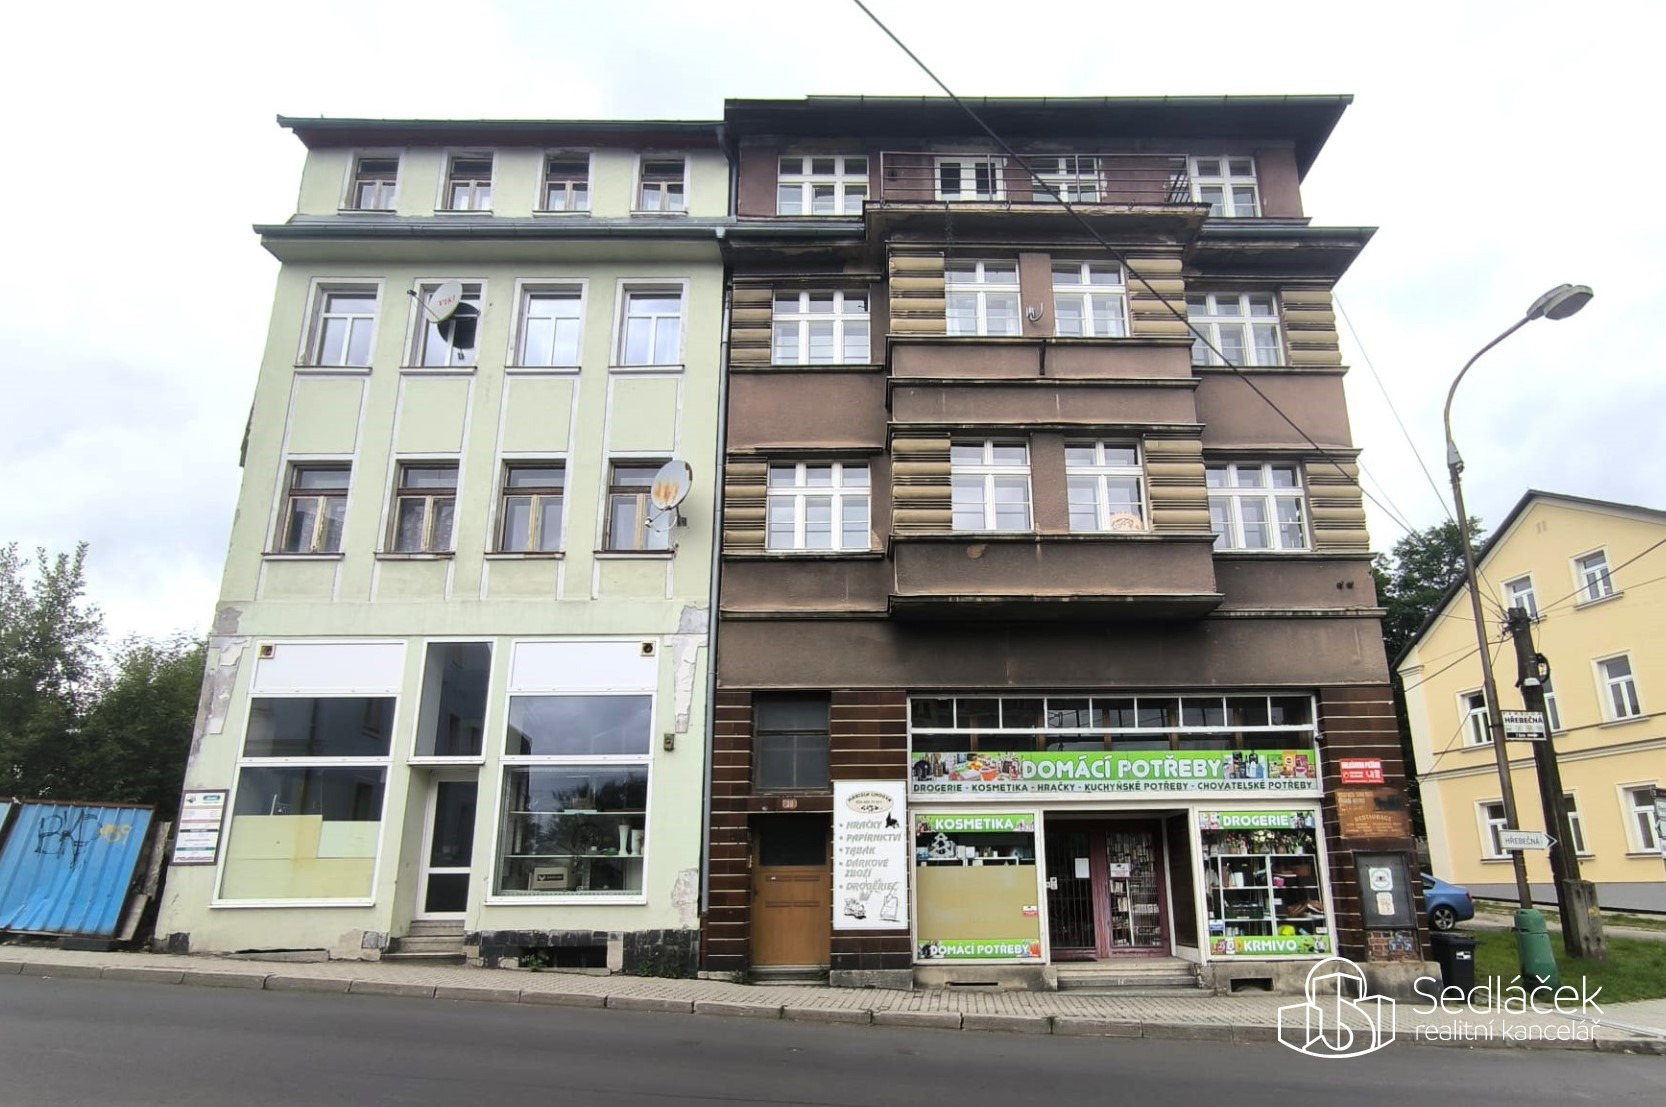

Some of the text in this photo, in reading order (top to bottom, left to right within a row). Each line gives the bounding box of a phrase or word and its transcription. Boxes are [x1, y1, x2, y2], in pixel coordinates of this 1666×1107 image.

[1504, 715, 1542, 724] HŘEBEČNÁ
[1022, 754, 1222, 779] DOMÁCÍ POTŘEBY
[913, 780, 1312, 792] DROGERIE KOSMETIKA HRAČKY KUCHYŇSKÉ POTŘEBY CHOVATELSKÉ POTŘEBY
[846, 819, 883, 830] HRAČKY
[935, 818, 1014, 830] KOSMETIKA
[1223, 815, 1289, 826] DROGERIE
[1505, 835, 1540, 845] HŘEBEČNÁ
[929, 942, 1030, 955] DOMÁCÍ POTŘEBY
[1243, 940, 1297, 952] KRMIVO
